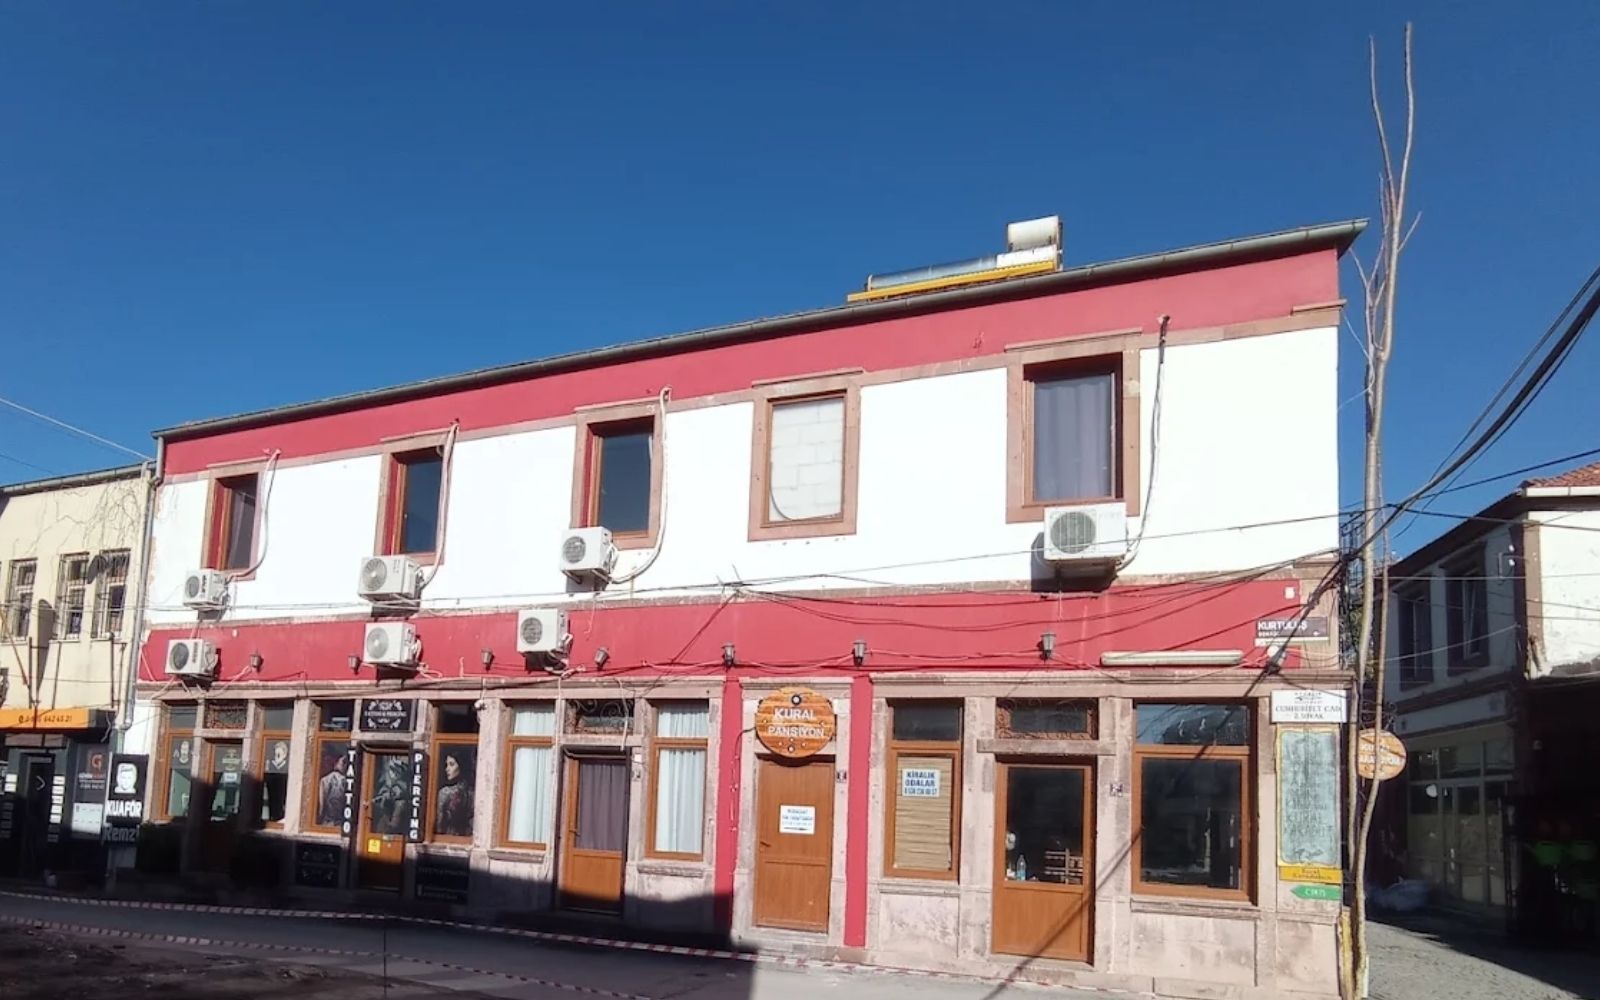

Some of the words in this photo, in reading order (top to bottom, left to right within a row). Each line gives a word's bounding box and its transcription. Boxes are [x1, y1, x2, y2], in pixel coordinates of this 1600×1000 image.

[774, 708, 816, 720] KURAL
[343, 750, 356, 833] TATTOO
[410, 753, 423, 839] PIERCING
